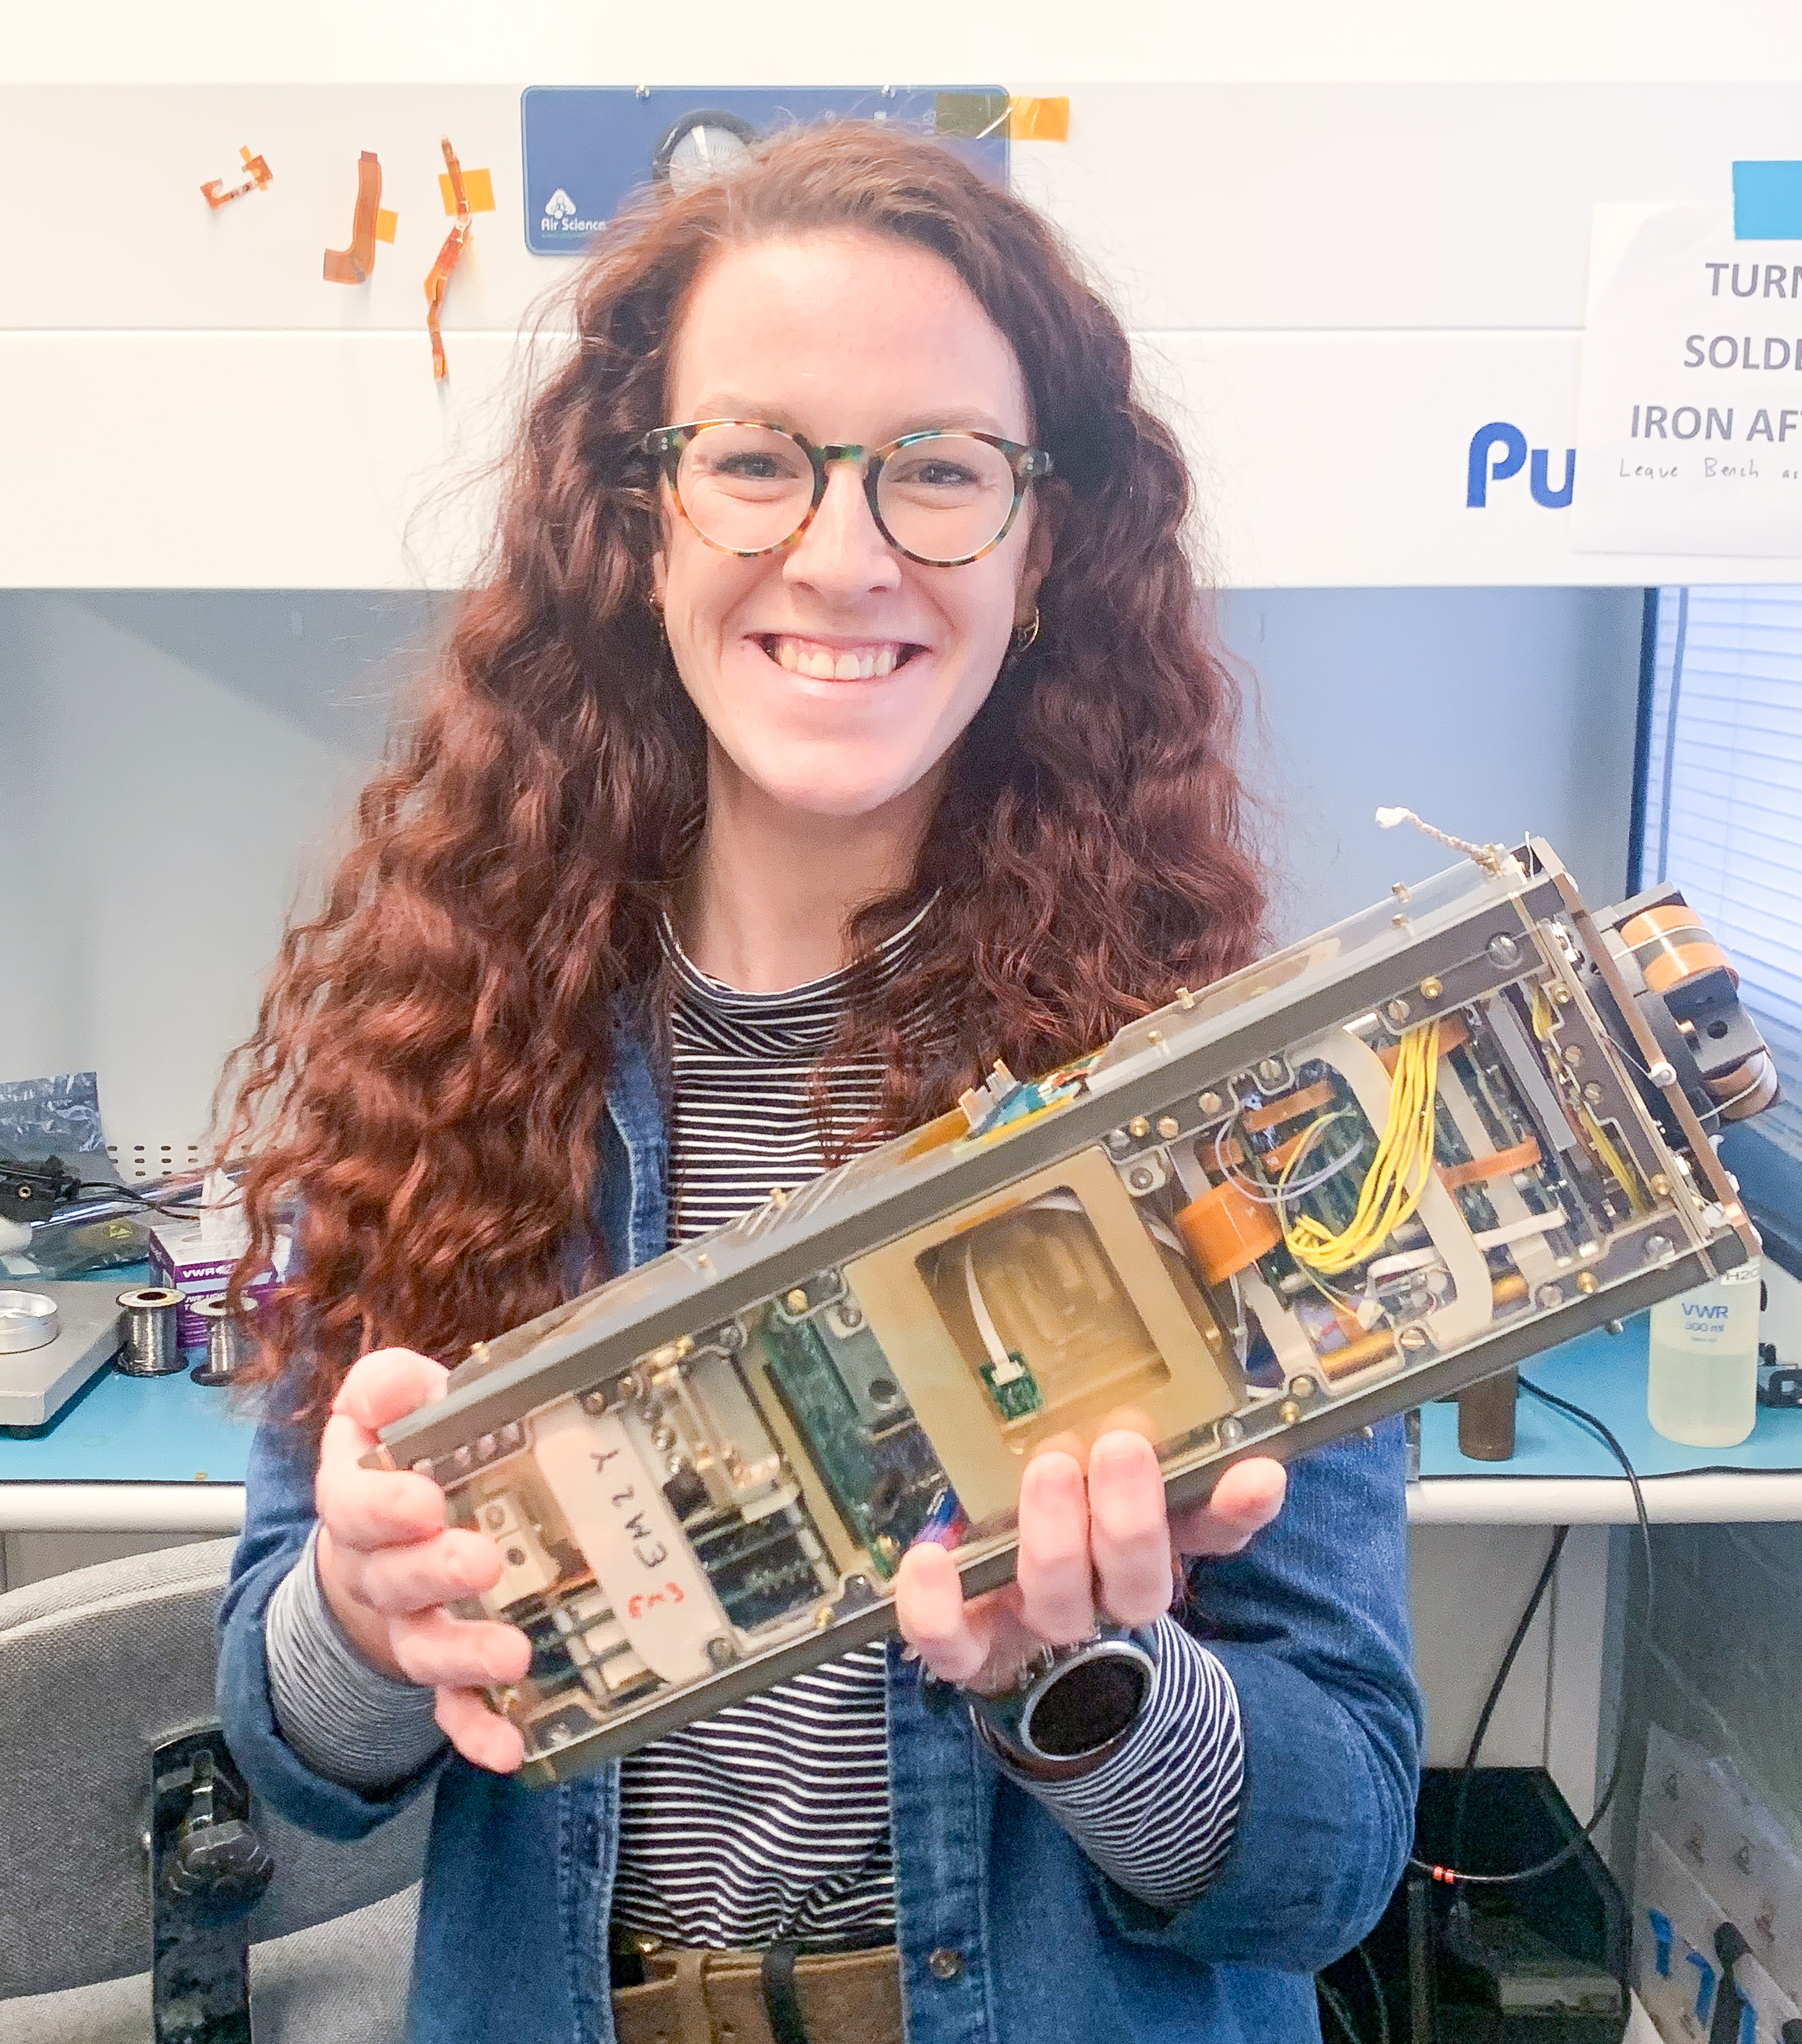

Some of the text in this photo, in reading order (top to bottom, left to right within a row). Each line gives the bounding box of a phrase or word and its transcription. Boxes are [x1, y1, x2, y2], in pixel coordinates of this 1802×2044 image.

[541, 217, 607, 231] Air Science
[1631, 405, 1802, 442] IRON AF
[1619, 458, 1679, 479] Leave
[1704, 457, 1759, 478] Bench
[182, 1266, 215, 1278] VWR
[1681, 1303, 1728, 1319] VWR
